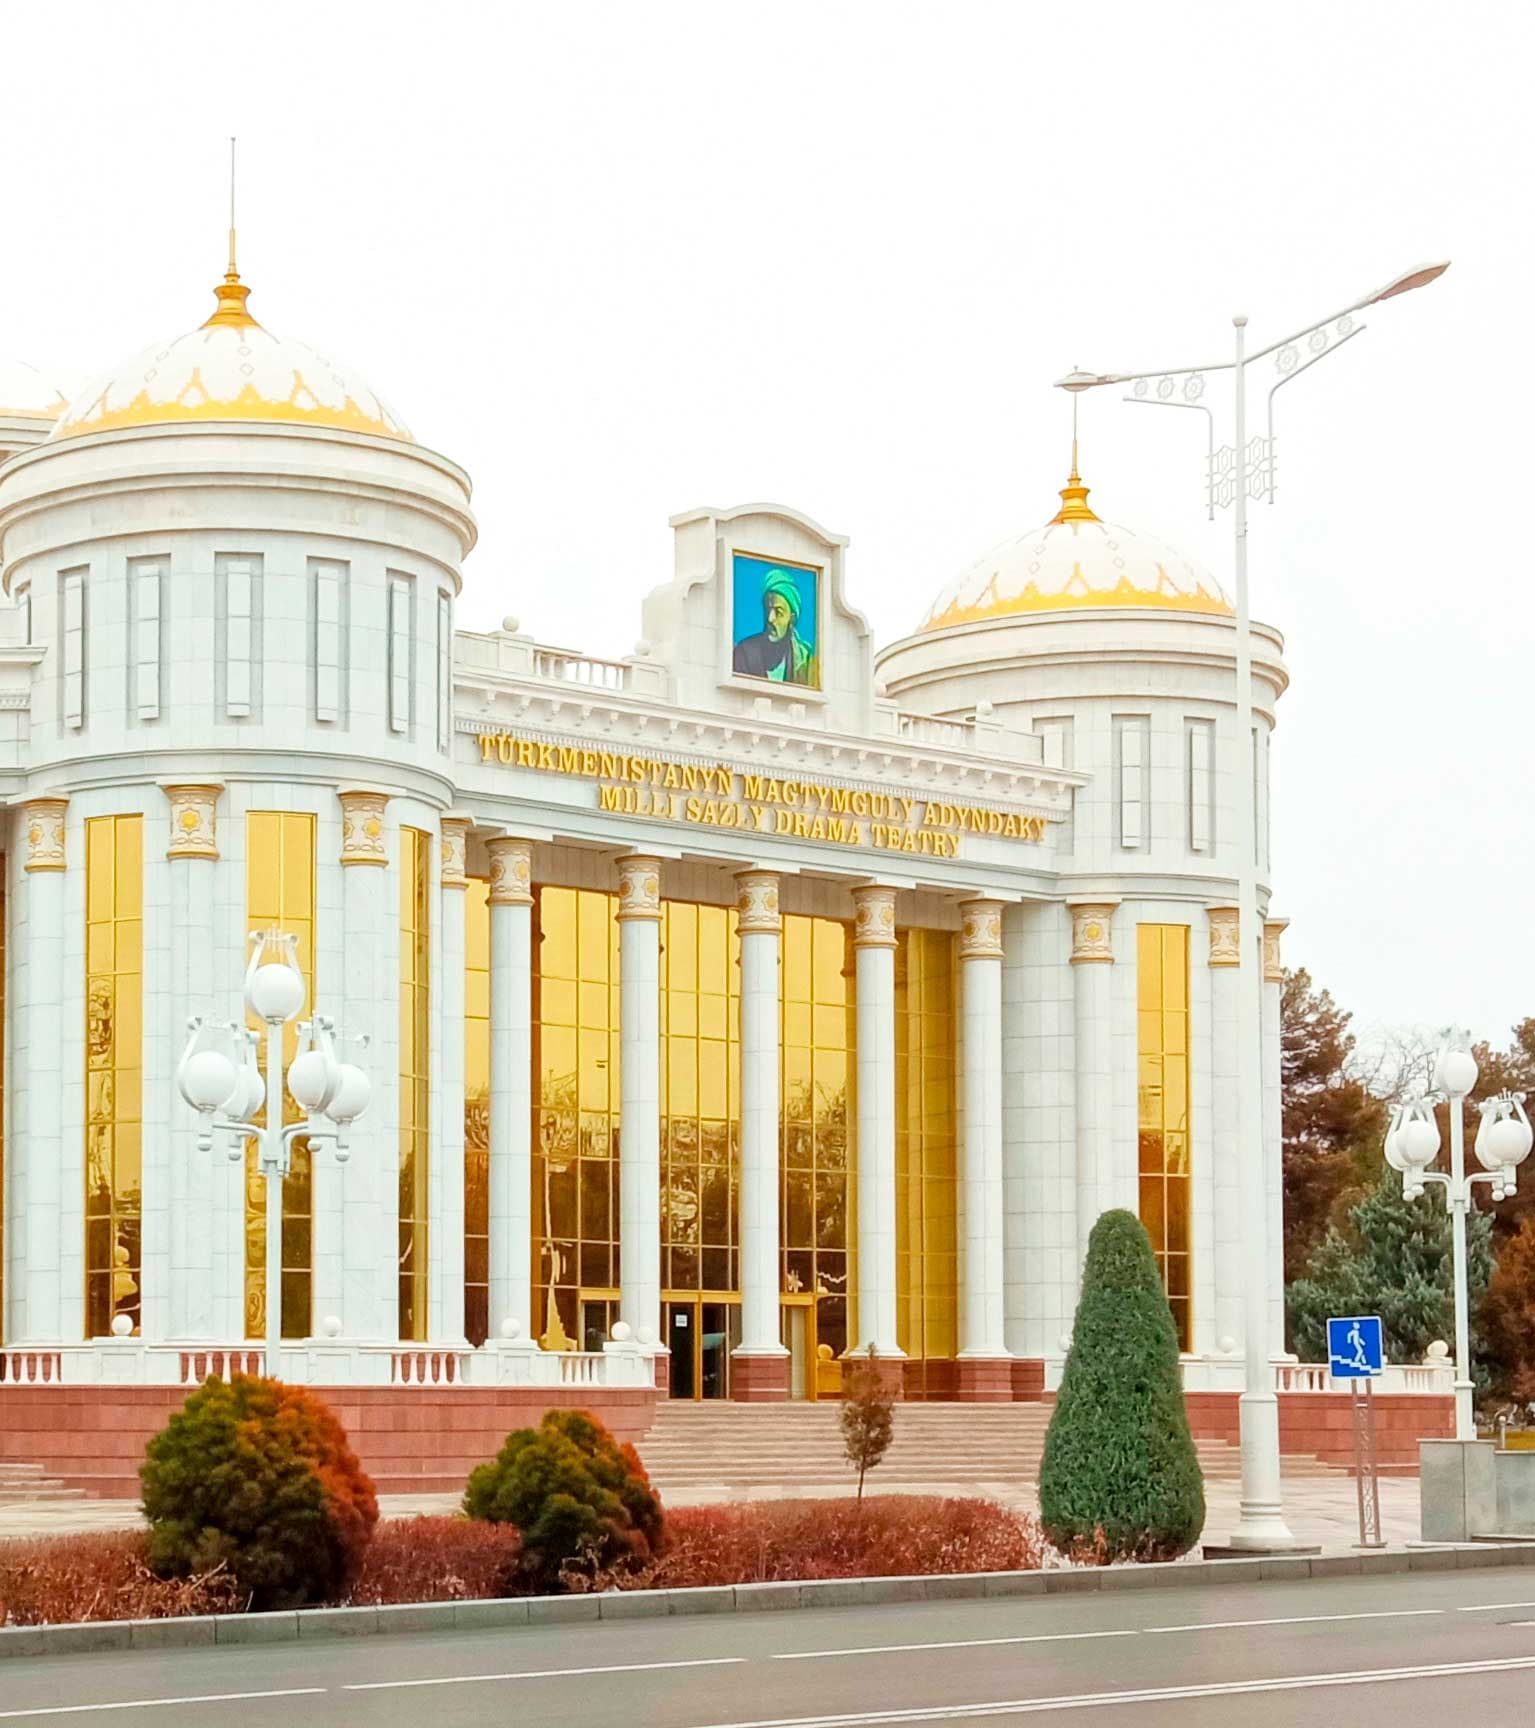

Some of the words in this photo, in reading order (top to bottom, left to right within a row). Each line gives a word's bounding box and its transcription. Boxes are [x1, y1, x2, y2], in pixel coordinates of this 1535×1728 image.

[599, 783, 678, 819] MILLI
[685, 796, 768, 834] SAZLY
[773, 808, 863, 845] DRAMA
[871, 822, 962, 859] TEATRY
[743, 774, 915, 823] MAGTYMGULY
[923, 802, 1049, 842] ADYNDAKY
